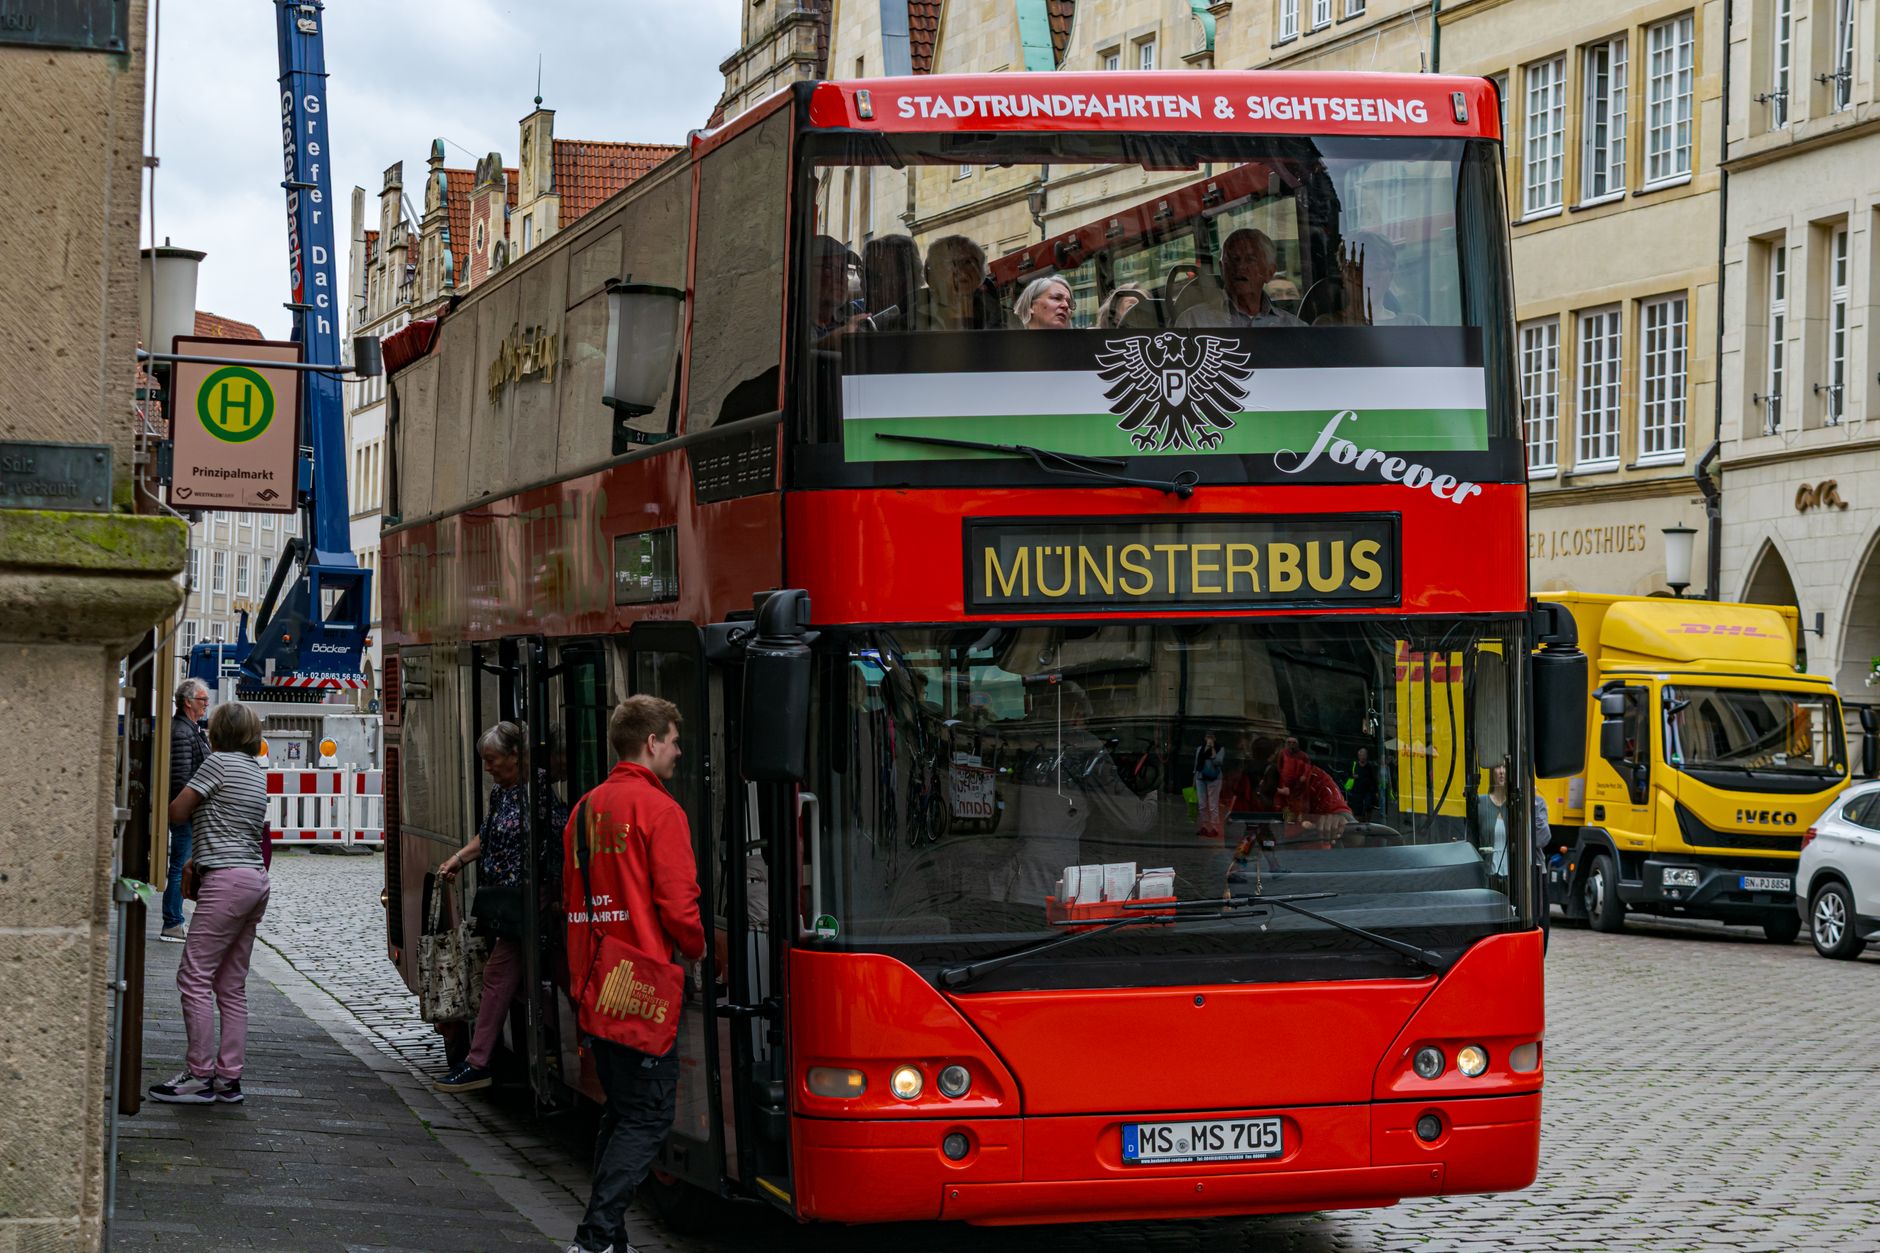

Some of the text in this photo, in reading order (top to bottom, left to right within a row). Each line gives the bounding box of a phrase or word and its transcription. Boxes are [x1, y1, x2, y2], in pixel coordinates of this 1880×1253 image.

[898, 94, 1429, 124] STADTRUNDFAHRTEN & SIGHTSEEING
[282, 91, 297, 184] Grefer
[303, 94, 331, 334] Grefer Dach
[1166, 372, 1184, 399] P
[220, 383, 252, 426] H
[1273, 409, 1483, 505] forever
[192, 466, 274, 481] Prinzipalmarkt
[984, 539, 1383, 598] MÜNSTERBUS
[1680, 623, 1768, 639] DHL
[312, 643, 351, 654] Böcker
[1736, 809, 1797, 826] IVECO
[634, 981, 656, 996] DER
[626, 998, 667, 1024] BUS
[1140, 1122, 1277, 1153] MS MS 705
